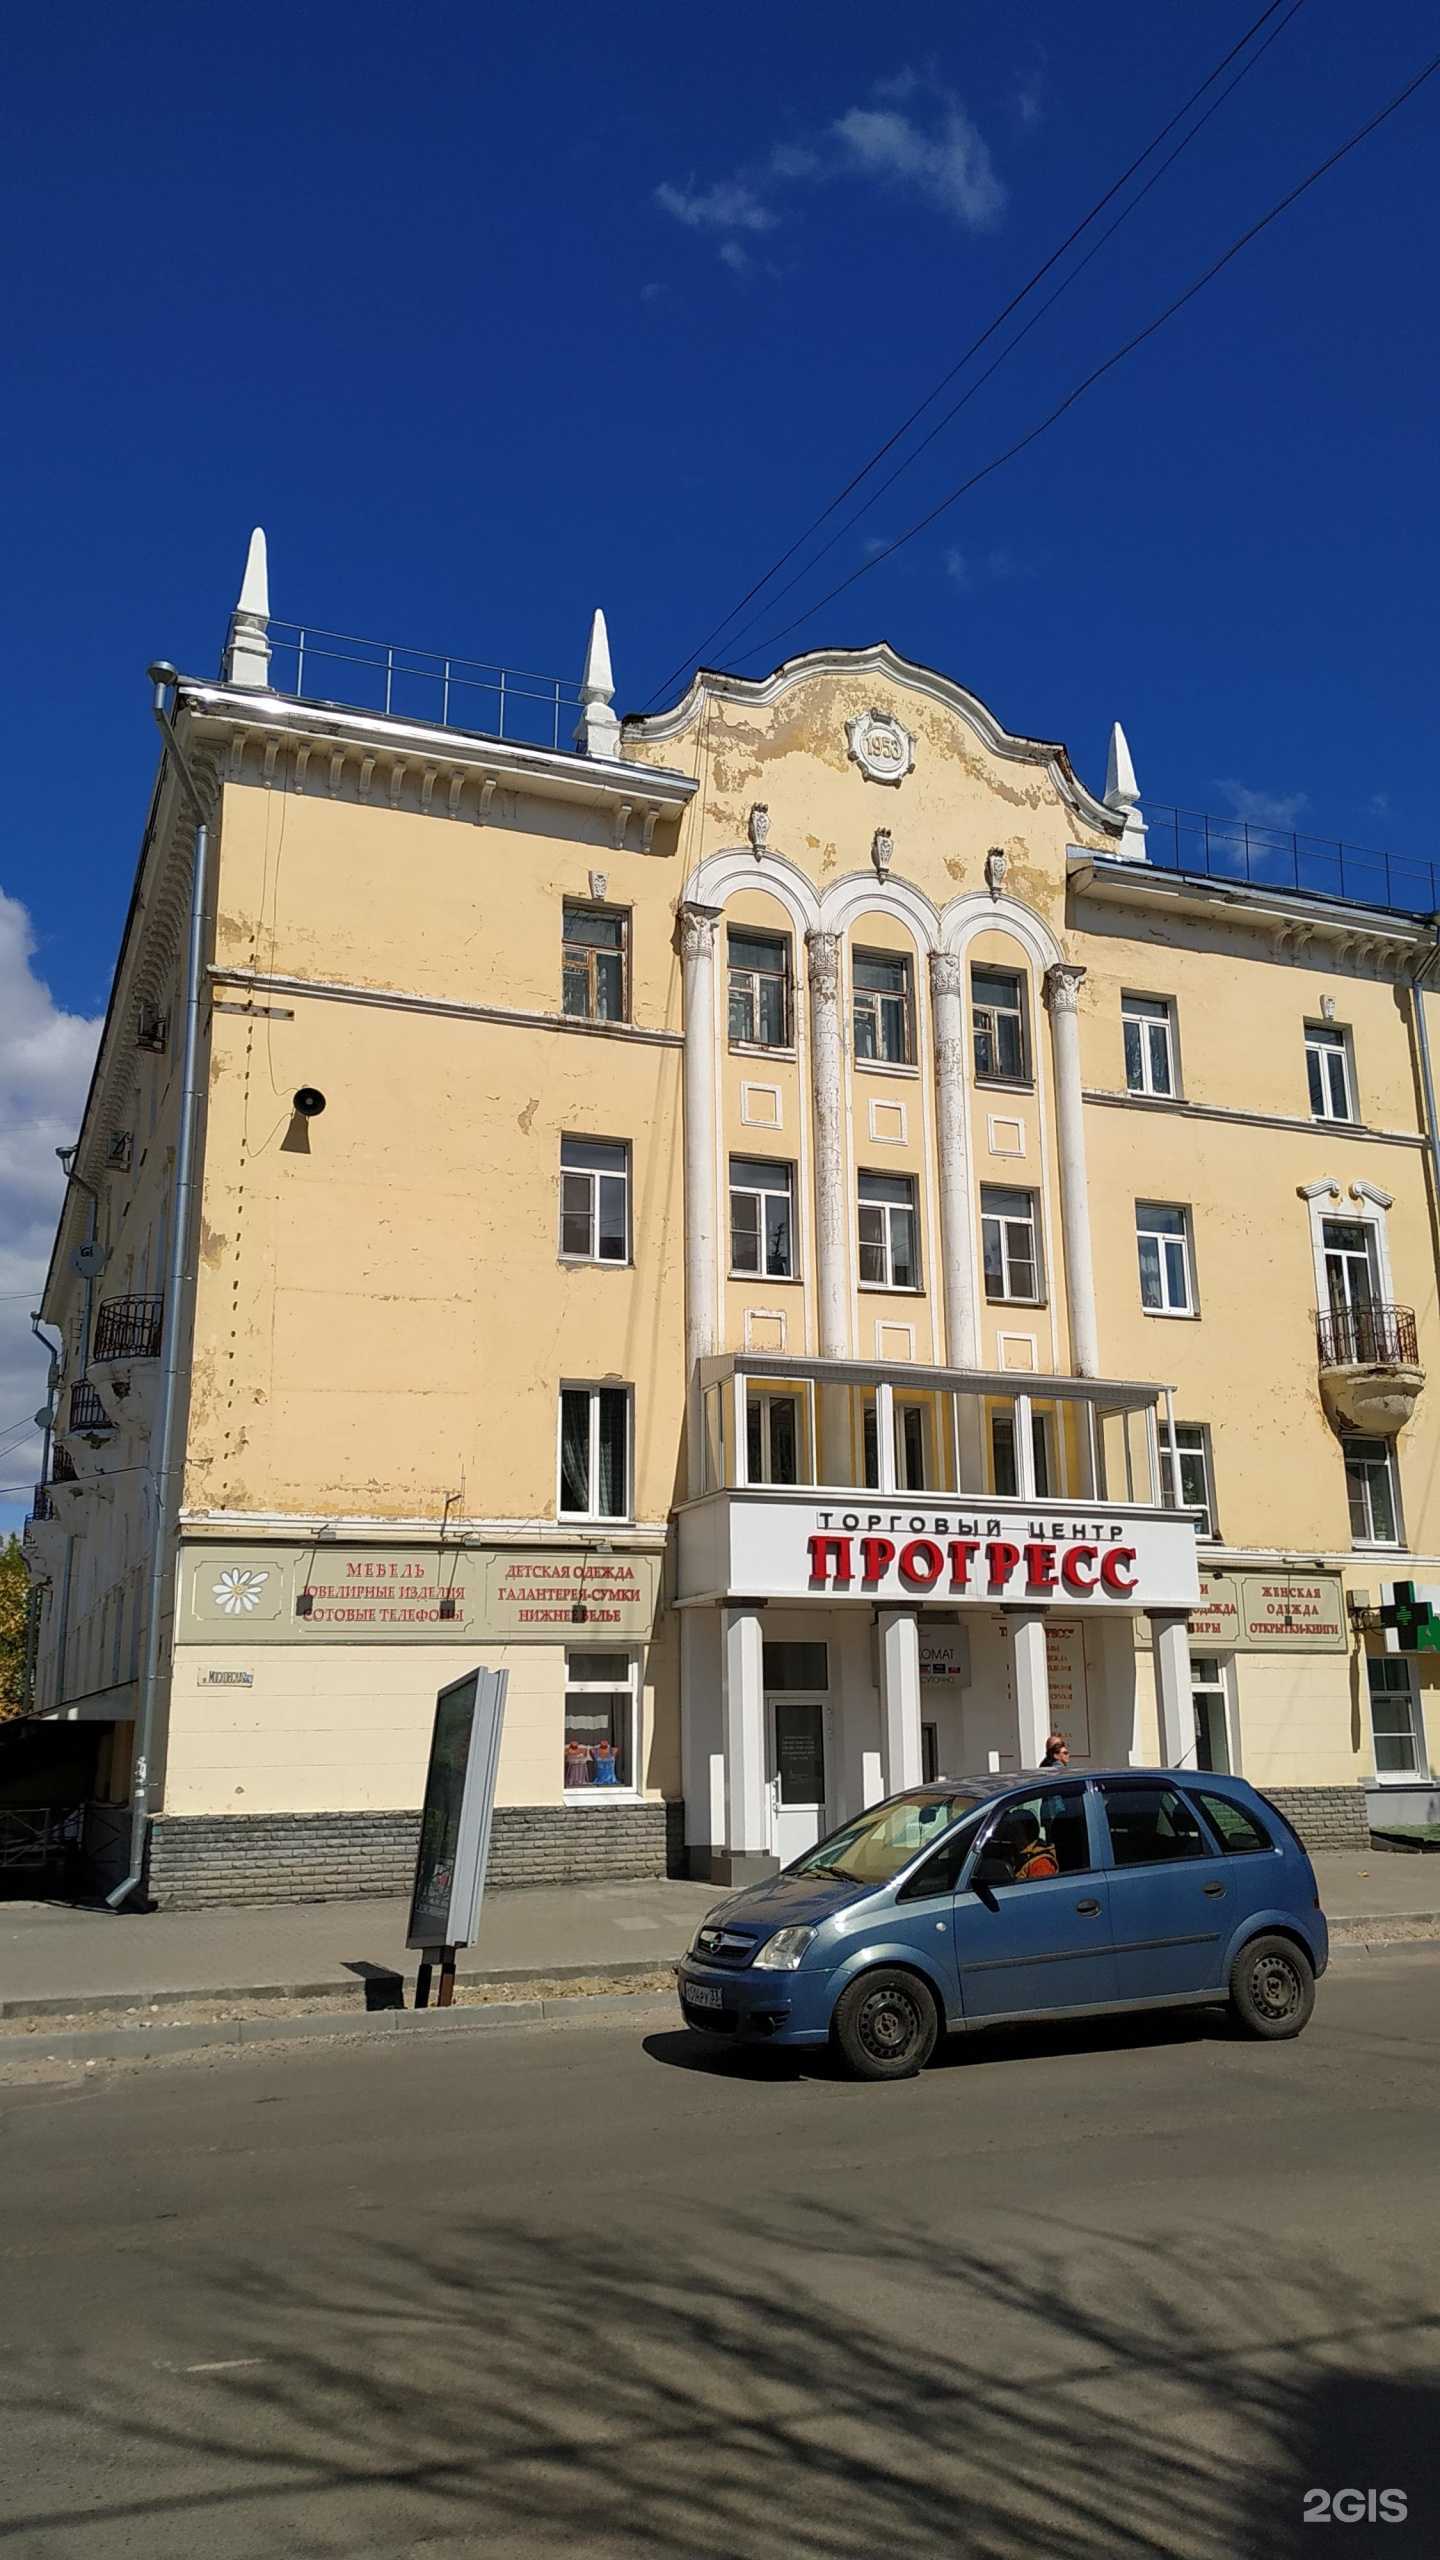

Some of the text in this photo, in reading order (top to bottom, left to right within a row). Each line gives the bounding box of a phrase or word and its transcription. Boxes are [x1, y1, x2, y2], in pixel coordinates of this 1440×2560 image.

[866, 736, 901, 761] 1953
[819, 1513, 1123, 1543] ТОРГОВЫЙ ЦЕНТР
[346, 1562, 425, 1578] МЕБЕЛЬ
[808, 1535, 1139, 1591] ПРОГРЕСС
[505, 1565, 635, 1582] ДЕТСКАЯ ОДЕЖДА
[303, 1585, 465, 1602] ЮВЕЛИРНЫЕ ИЗДЕЛИЯ
[498, 1587, 641, 1602] ГАЛАНТЕРЕЯ-СУМКИ
[1262, 1586, 1321, 1599] ЖЕНСКАЯ
[303, 1608, 465, 1623] СОТОВЫЕ ТЕЛЕФОНЫ
[1266, 1603, 1320, 1617] ОДЕЖДА
[919, 1648, 954, 1660] ОМАТ
